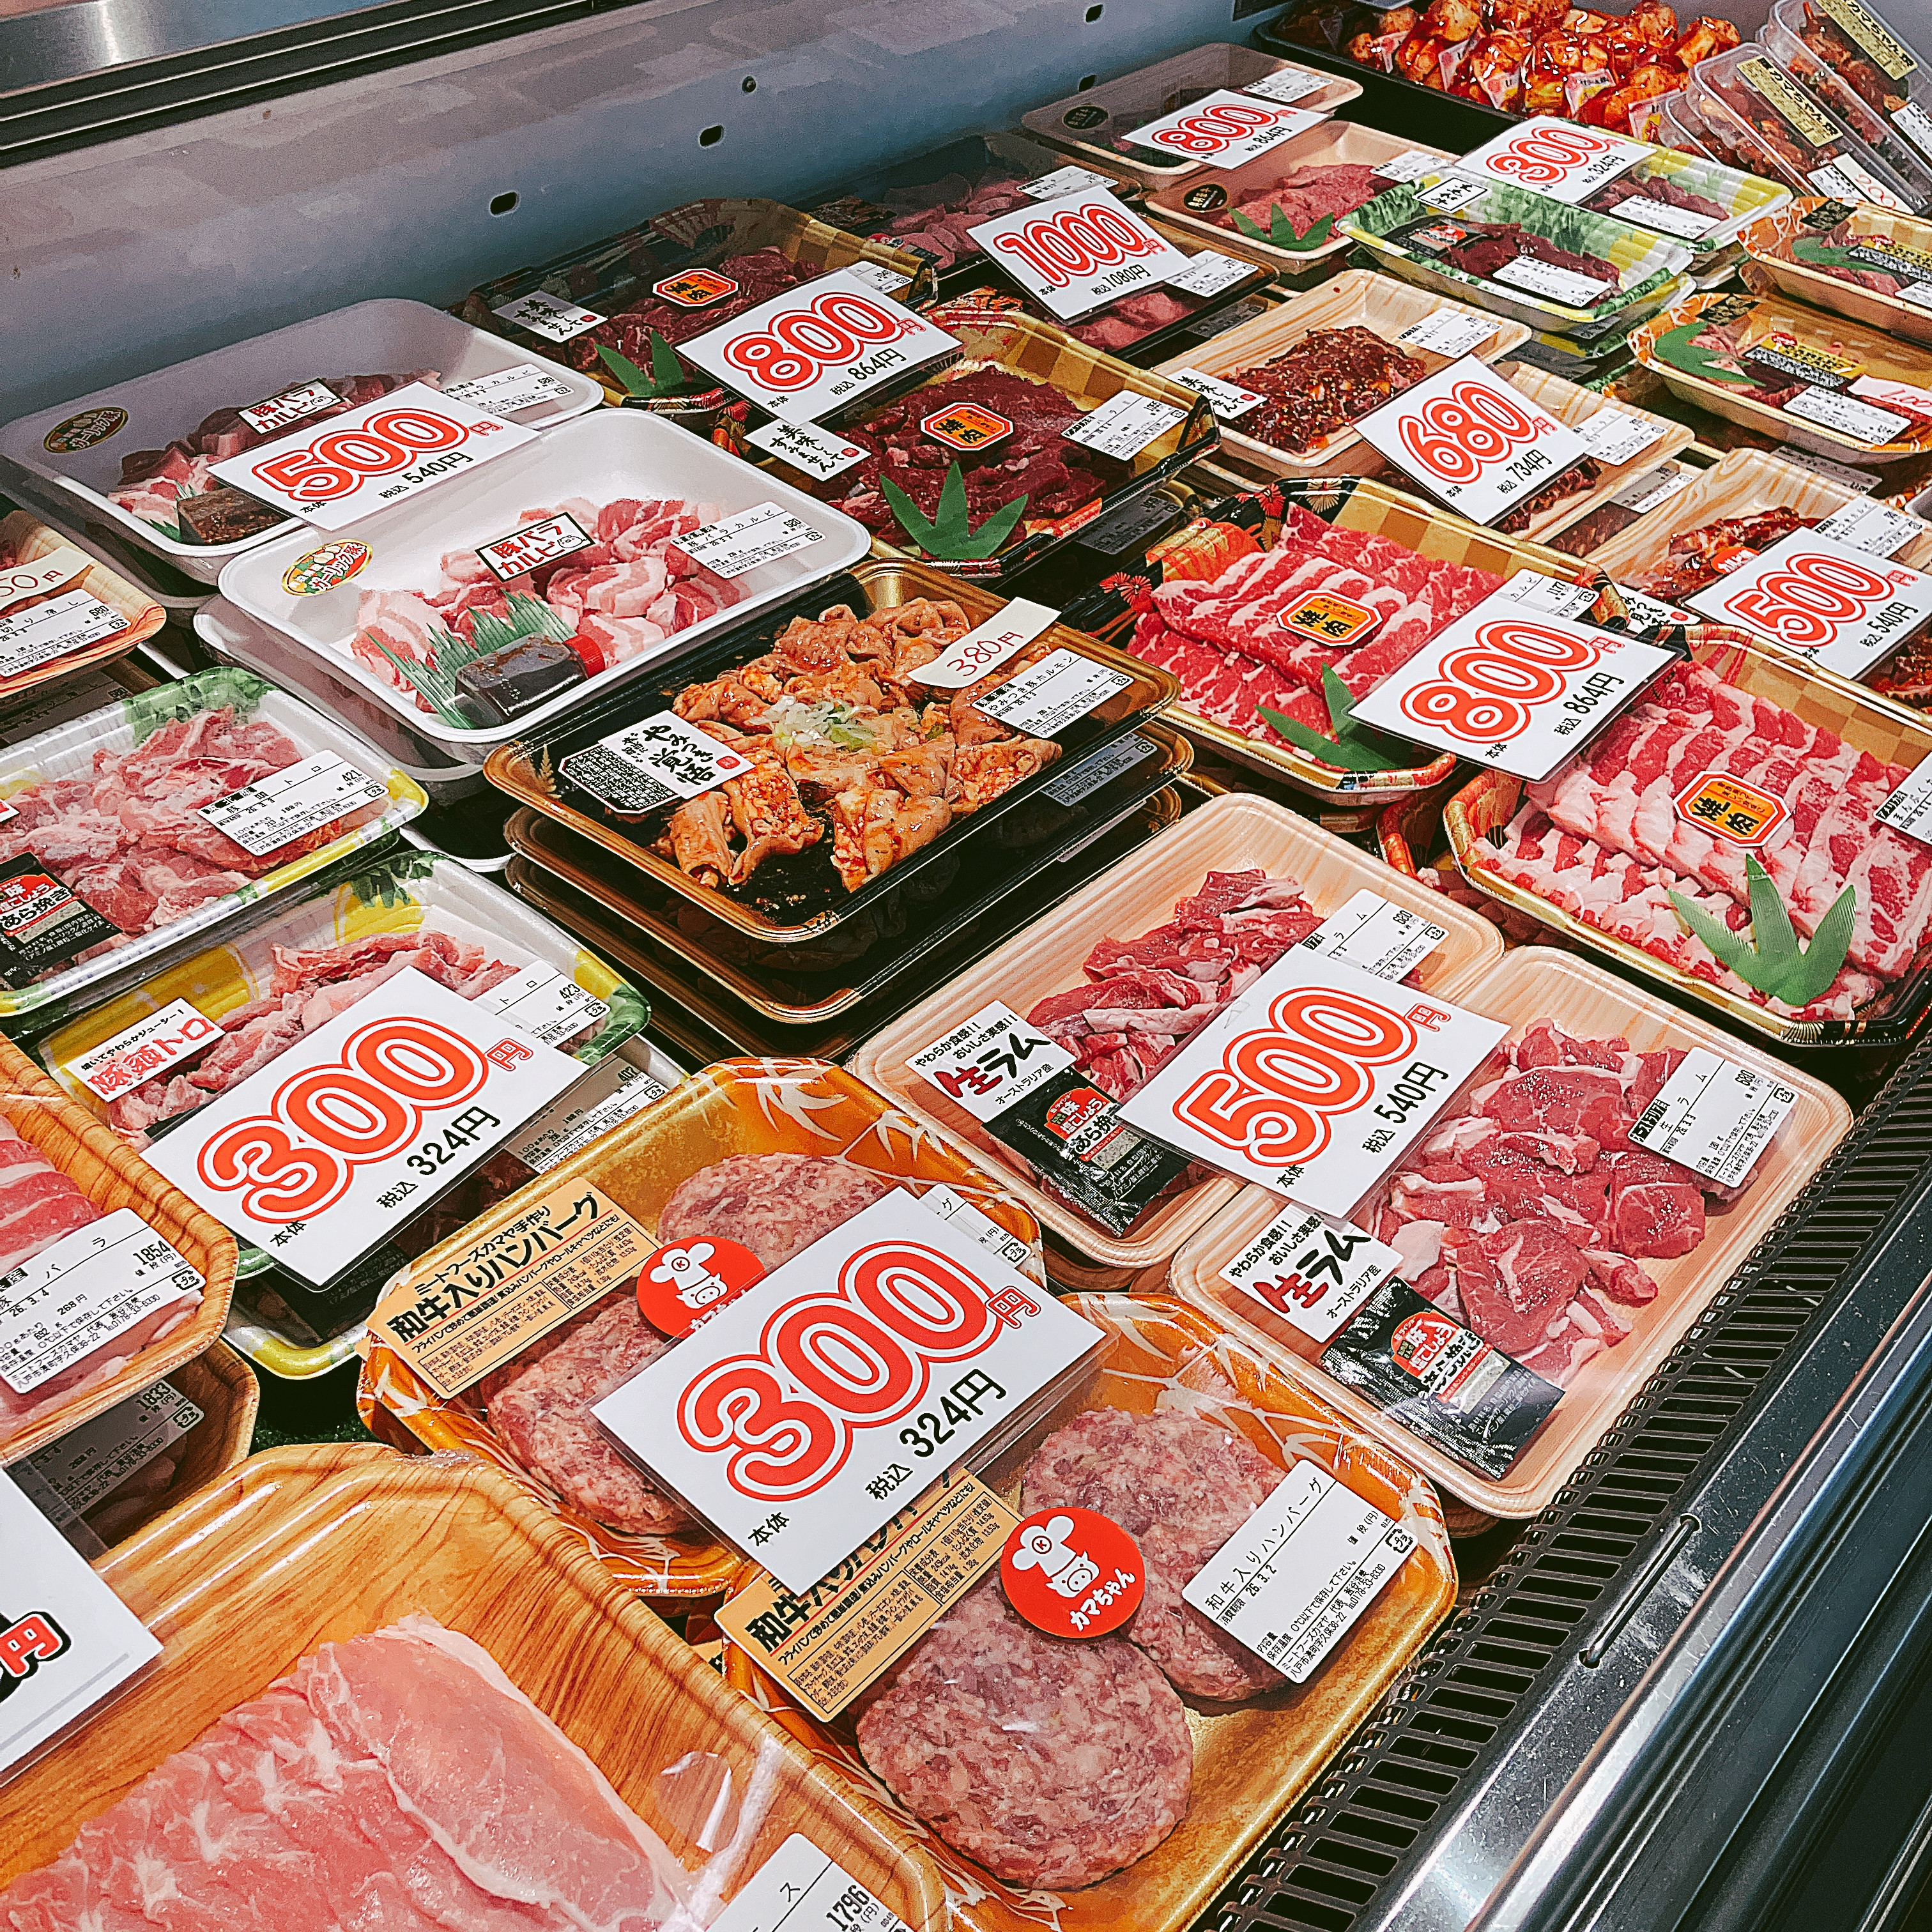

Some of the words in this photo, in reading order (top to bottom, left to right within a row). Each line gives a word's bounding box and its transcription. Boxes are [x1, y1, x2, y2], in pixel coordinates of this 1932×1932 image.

[1151, 104, 1296, 154] 800円
[993, 202, 1167, 288] 1000円
[1102, 264, 1151, 287] 1080円
[721, 291, 930, 392] 800円
[847, 346, 907, 379] 864円
[252, 404, 502, 502] 500円
[1399, 381, 1561, 486] 680円
[407, 452, 475, 484] 540円
[1506, 450, 1552, 481] 734円
[493, 522, 562, 558] 豚バラ
[498, 540, 559, 574] カルビ
[1724, 553, 1919, 648] 500円
[1875, 602, 1919, 636] 540円
[947, 630, 1023, 677] 380円
[1400, 614, 1625, 745] 800円
[1563, 673, 1624, 714] 864円
[342, 769, 362, 785] 421
[1692, 797, 1759, 835] 焼肉
[1, 887, 72, 929] あら挽き
[560, 983, 581, 1001] 423
[934, 1033, 1050, 1098] 生ラム
[1172, 986, 1451, 1167] 500円
[1374, 1062, 1448, 1123] 540円
[197, 1015, 535, 1224] 300円
[270, 1220, 306, 1246] 本体
[376, 1182, 418, 1208] 税込
[407, 1107, 500, 1175] 324円
[132, 1239, 171, 1266] 1854
[387, 1192, 600, 1344] 和牛入りハンバーグ
[415, 1206, 552, 1295] ミートフーズカマヤ手作り
[1253, 1228, 1372, 1314] 生ラム
[57, 1293, 88, 1316] 268円
[1326, 1264, 1382, 1319] オーストラリア産
[135, 1382, 172, 1409] 1833
[677, 1241, 1044, 1508] 300円
[748, 1512, 789, 1546] 本体
[866, 1464, 913, 1499] 税込
[900, 1369, 1006, 1457] 324円
[1205, 1476, 1322, 1611] 和牛入りハンバーグ
[1070, 1568, 1137, 1629] カマちゃん
[826, 1885, 870, 1932] 1796
